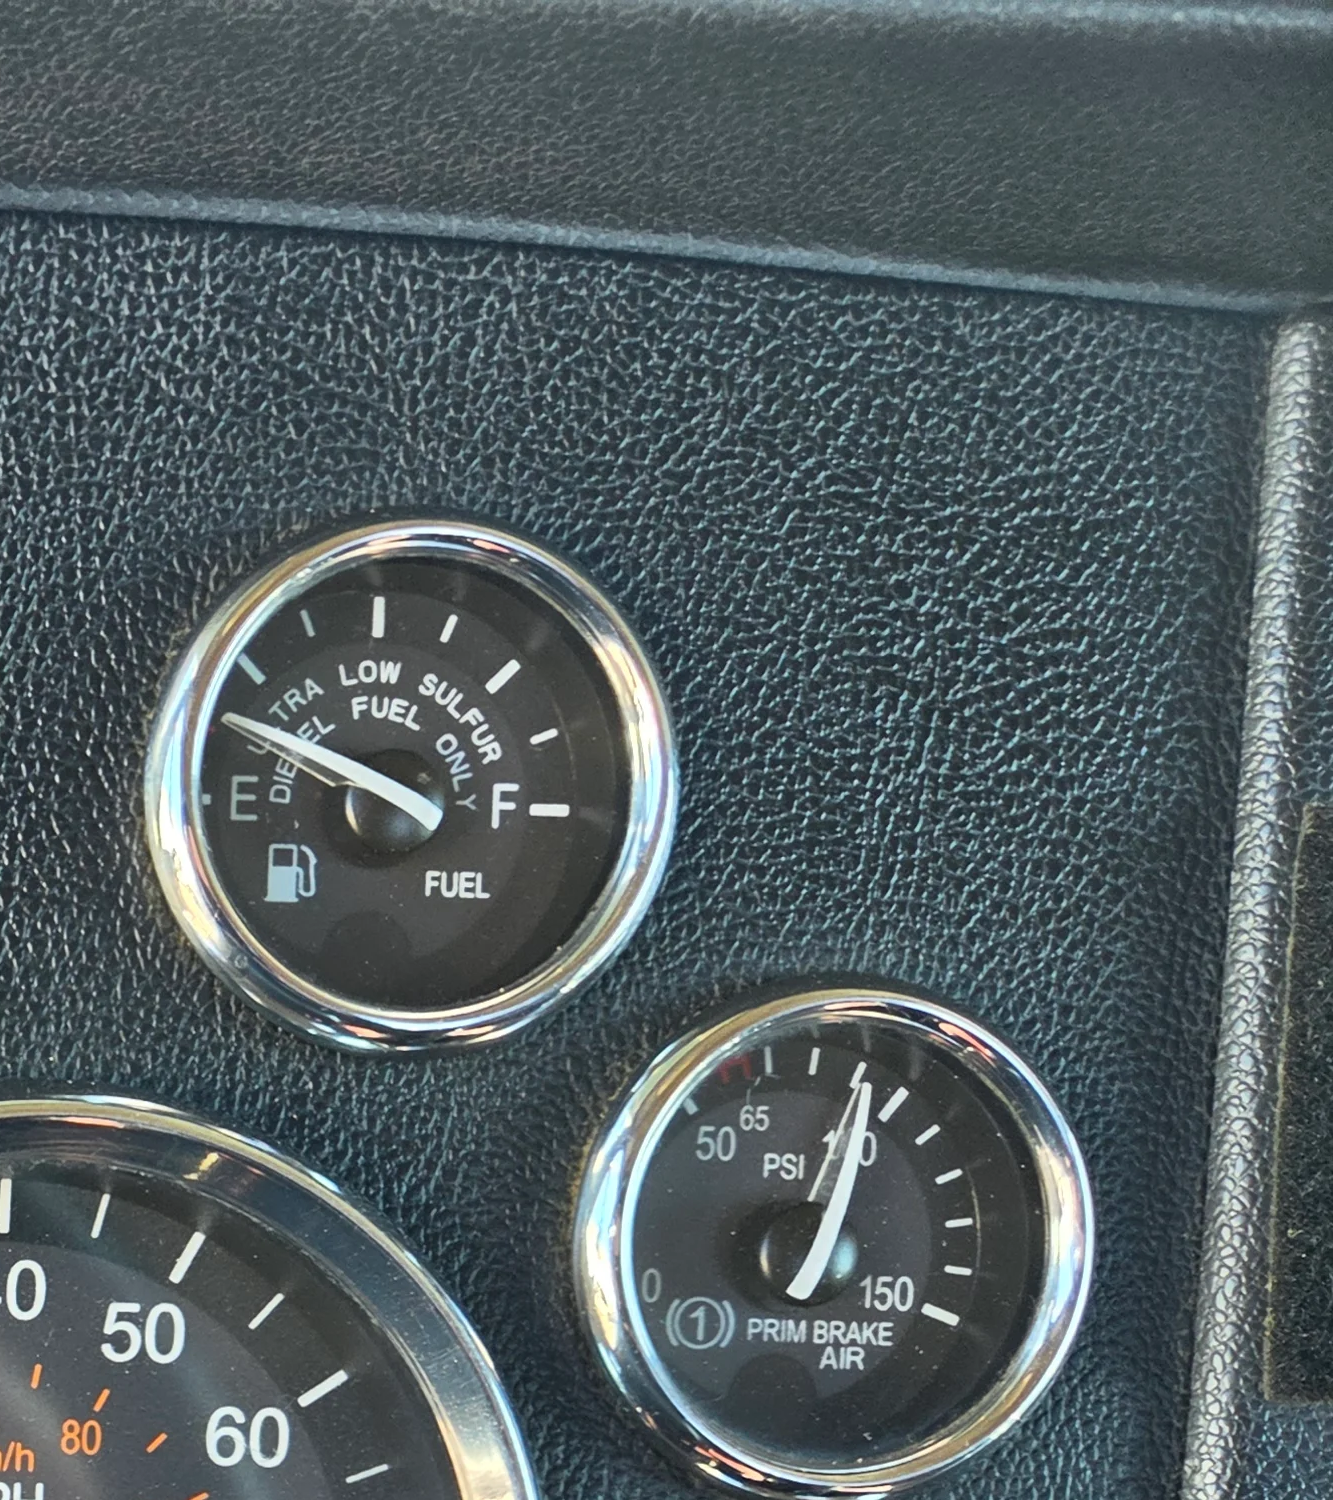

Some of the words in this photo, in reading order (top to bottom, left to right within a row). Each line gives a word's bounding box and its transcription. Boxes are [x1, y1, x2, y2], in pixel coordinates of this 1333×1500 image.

[247, 678, 323, 756] UTRA
[339, 661, 402, 686] LOW
[419, 673, 503, 766] SULFUR
[269, 715, 336, 805] DIEEL
[351, 696, 421, 732] FUEL
[436, 733, 478, 810] ONLY
[230, 776, 259, 821] E
[491, 783, 520, 829] F
[425, 871, 491, 899] FUEL
[740, 1105, 770, 1131] 65
[696, 1126, 736, 1161] 50
[763, 1153, 805, 1180] PSI
[642, 1268, 662, 1302] 0
[860, 1275, 914, 1311] 150
[101, 1303, 186, 1364] 50
[746, 1318, 807, 1344] PRIM
[813, 1320, 894, 1347] BRAKE
[819, 1346, 865, 1370] AIR
[60, 1419, 103, 1456] 80
[205, 1407, 290, 1468] 60
